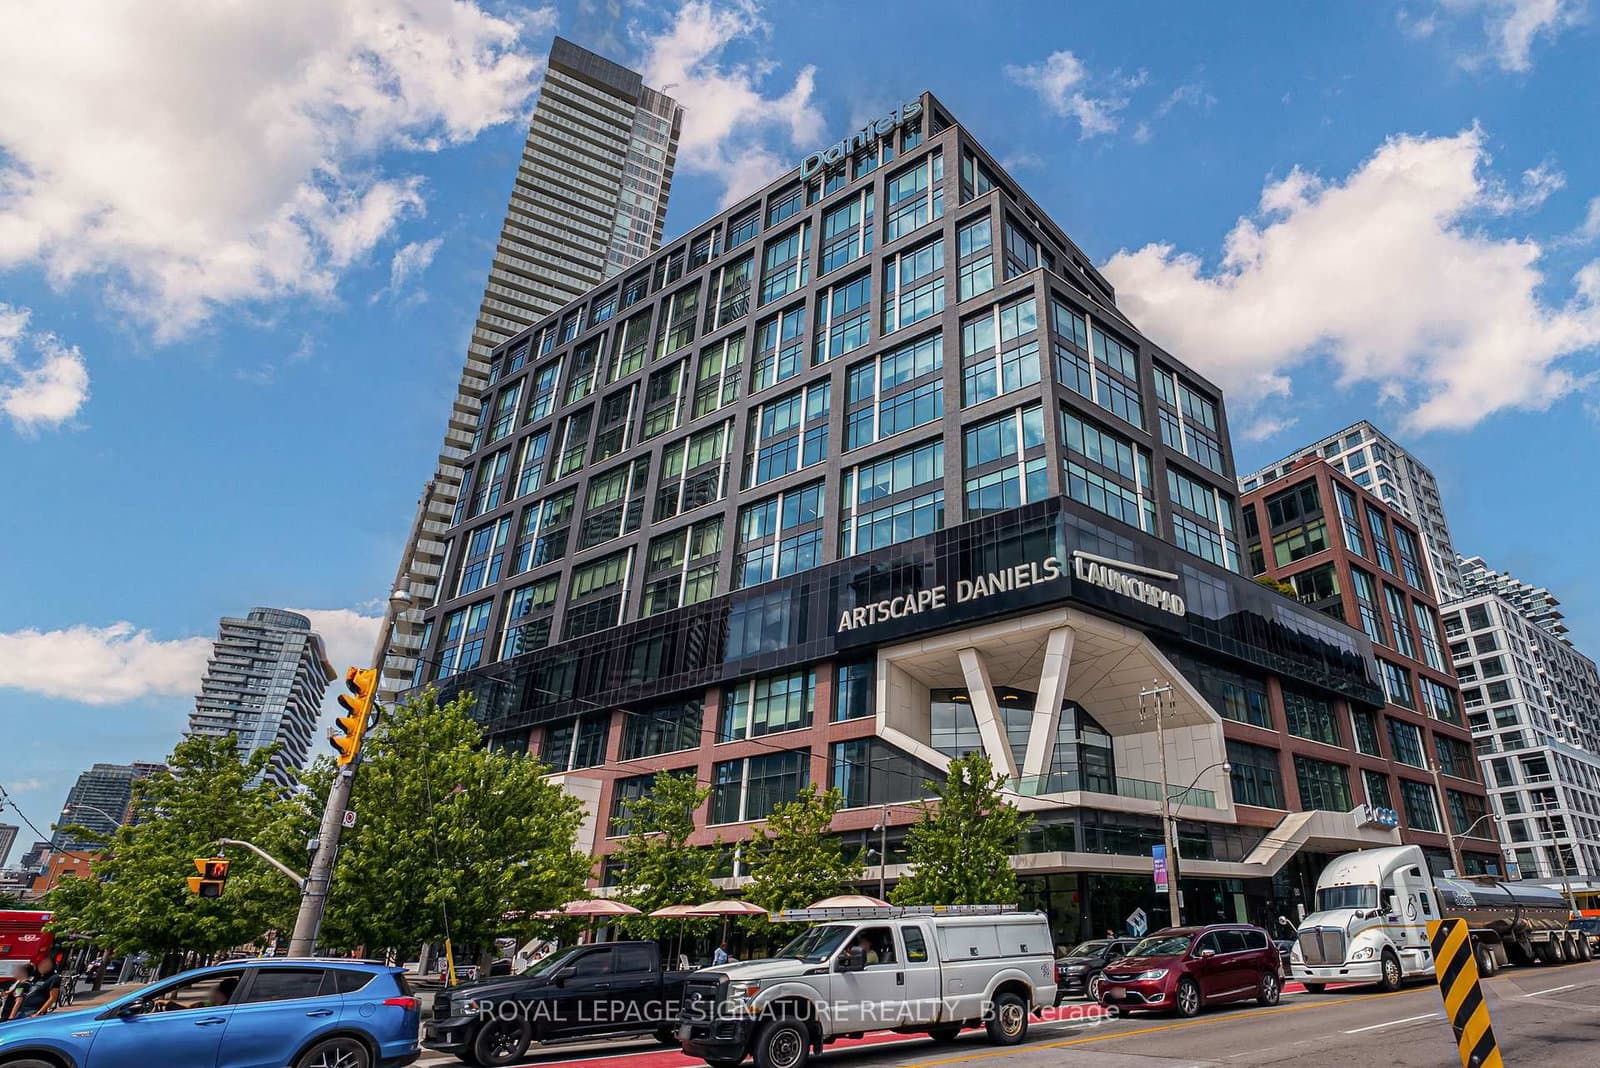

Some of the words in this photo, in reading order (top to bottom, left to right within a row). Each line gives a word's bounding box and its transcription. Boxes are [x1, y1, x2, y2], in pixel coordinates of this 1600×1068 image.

[800, 100, 924, 181] Daniels
[838, 585, 946, 632] ARTSCAPE
[956, 557, 1061, 603] DANIELS
[1074, 556, 1185, 616] LAUNCHPAD
